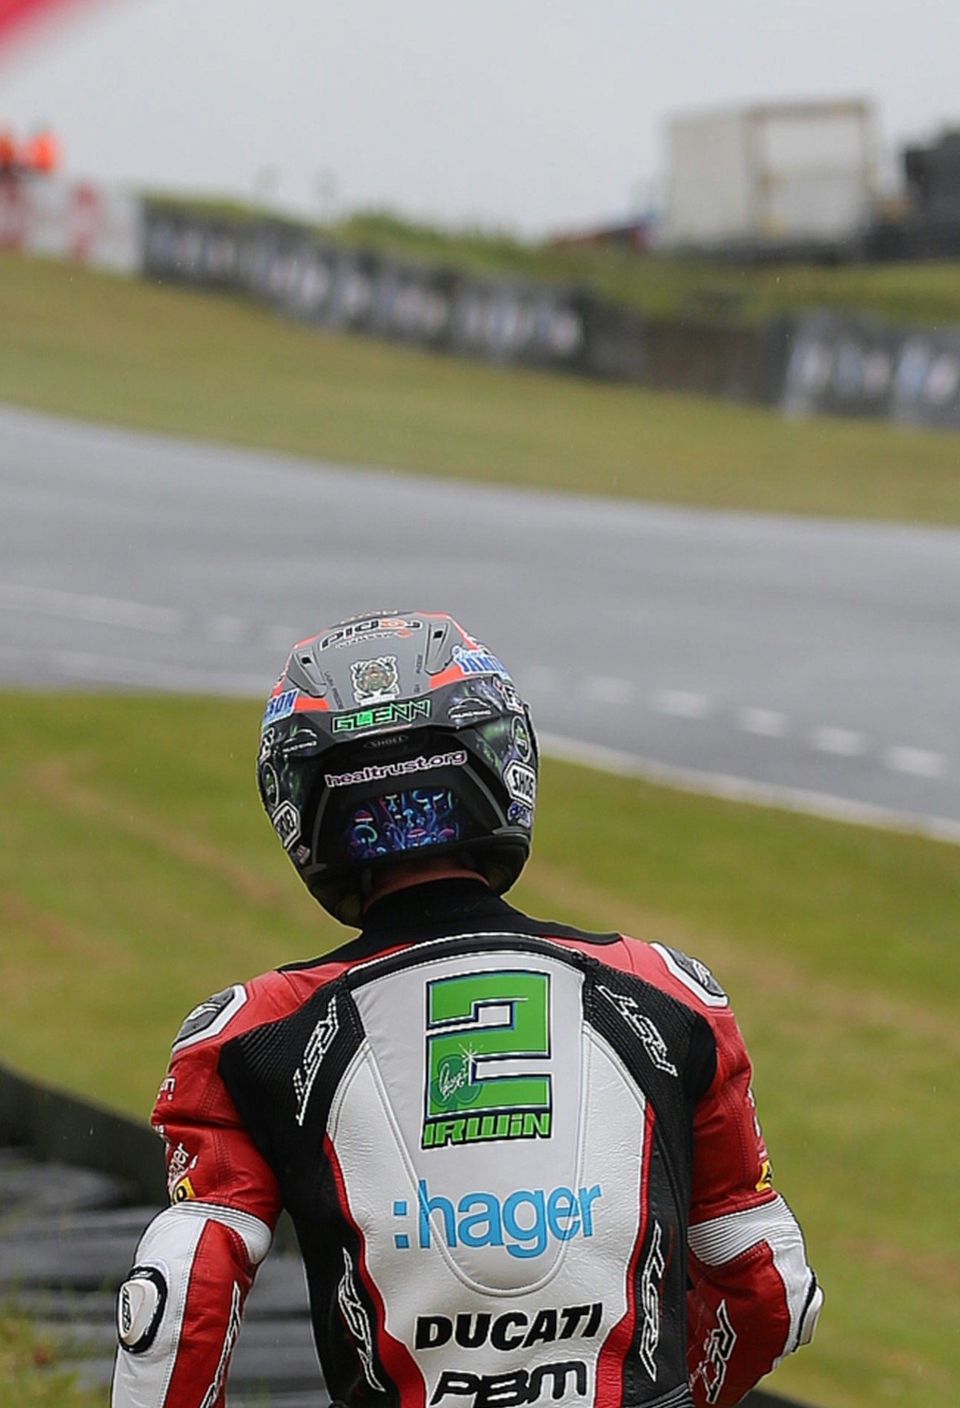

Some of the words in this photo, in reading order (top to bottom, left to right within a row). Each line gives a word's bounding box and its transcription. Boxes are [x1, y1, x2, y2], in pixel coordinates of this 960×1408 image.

[333, 699, 431, 733] GLENN
[324, 750, 468, 788] healtrust.org
[426, 969, 552, 1119] 2
[415, 1302, 603, 1351] DUCATI
